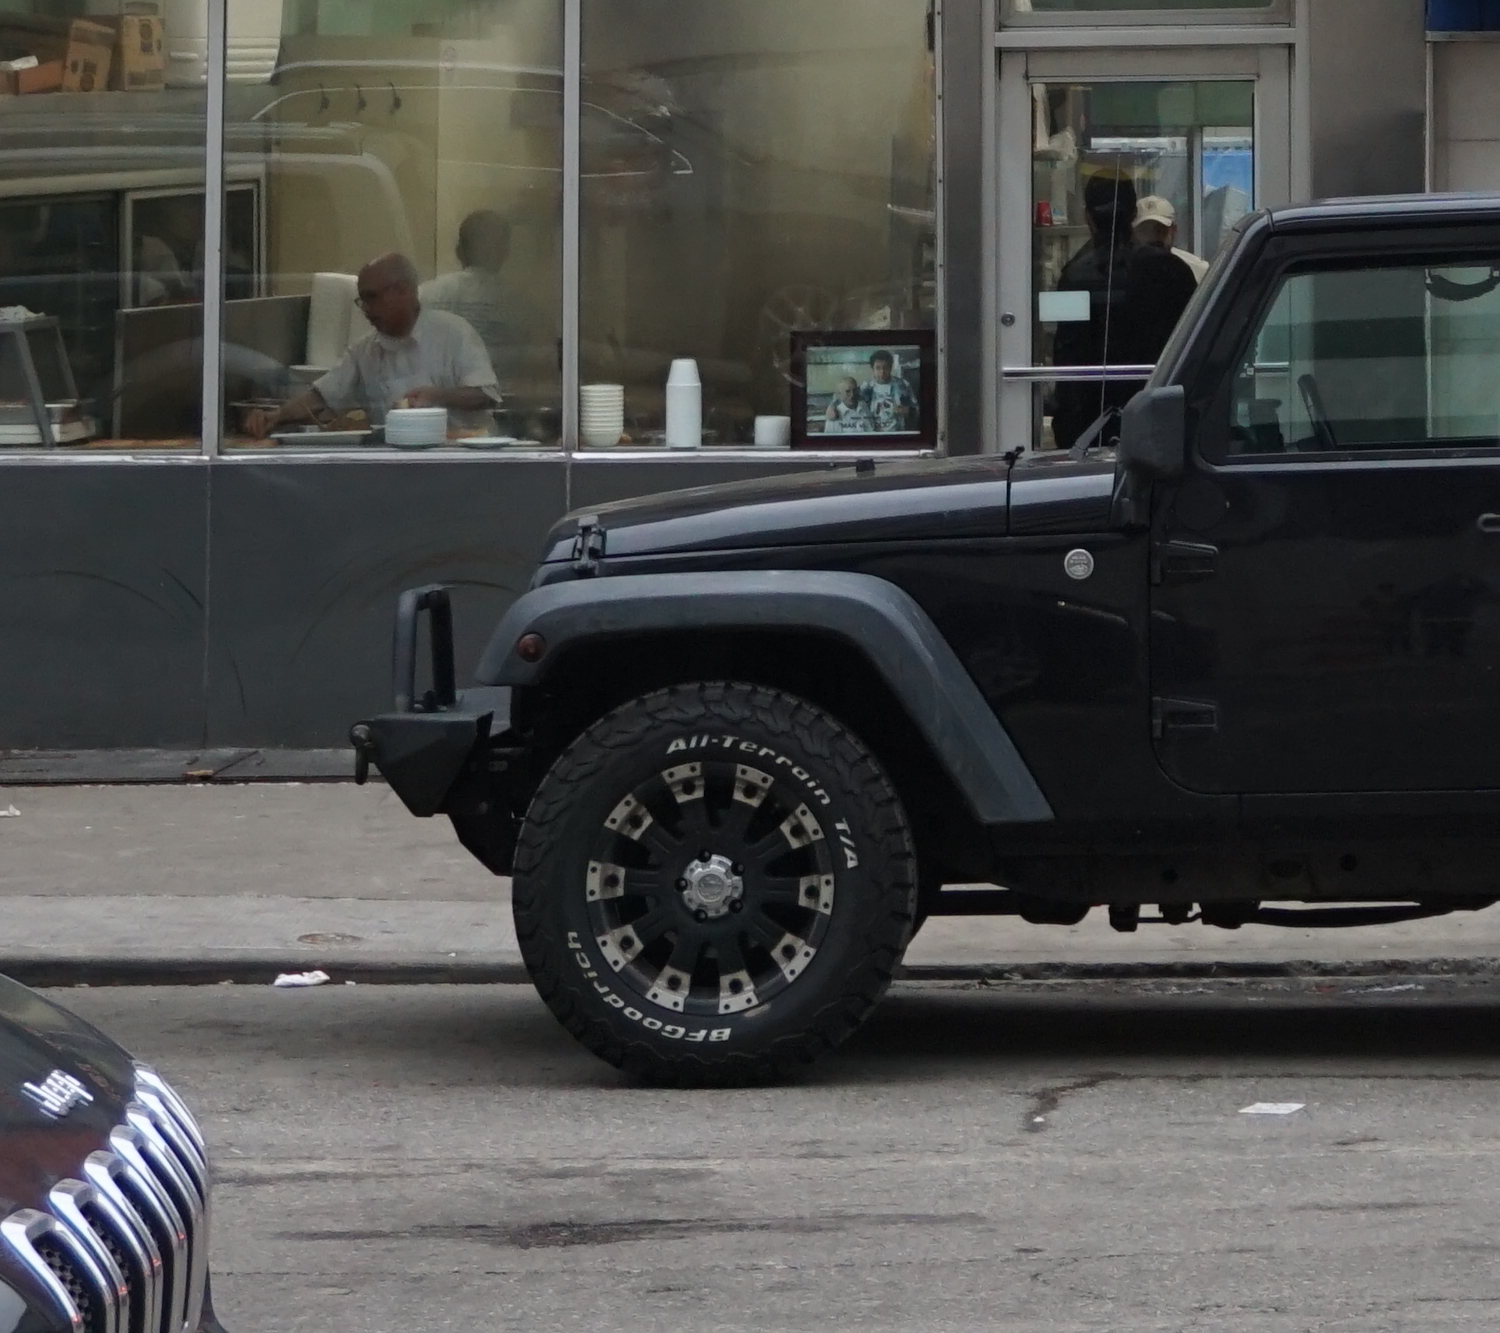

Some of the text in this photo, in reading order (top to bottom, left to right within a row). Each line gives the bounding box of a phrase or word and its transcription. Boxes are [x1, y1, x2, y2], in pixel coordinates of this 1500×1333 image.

[666, 734, 859, 870] All-Terrain T/A
[567, 930, 733, 1043] BFGoodrich
[21, 1069, 94, 1120] Jeep
